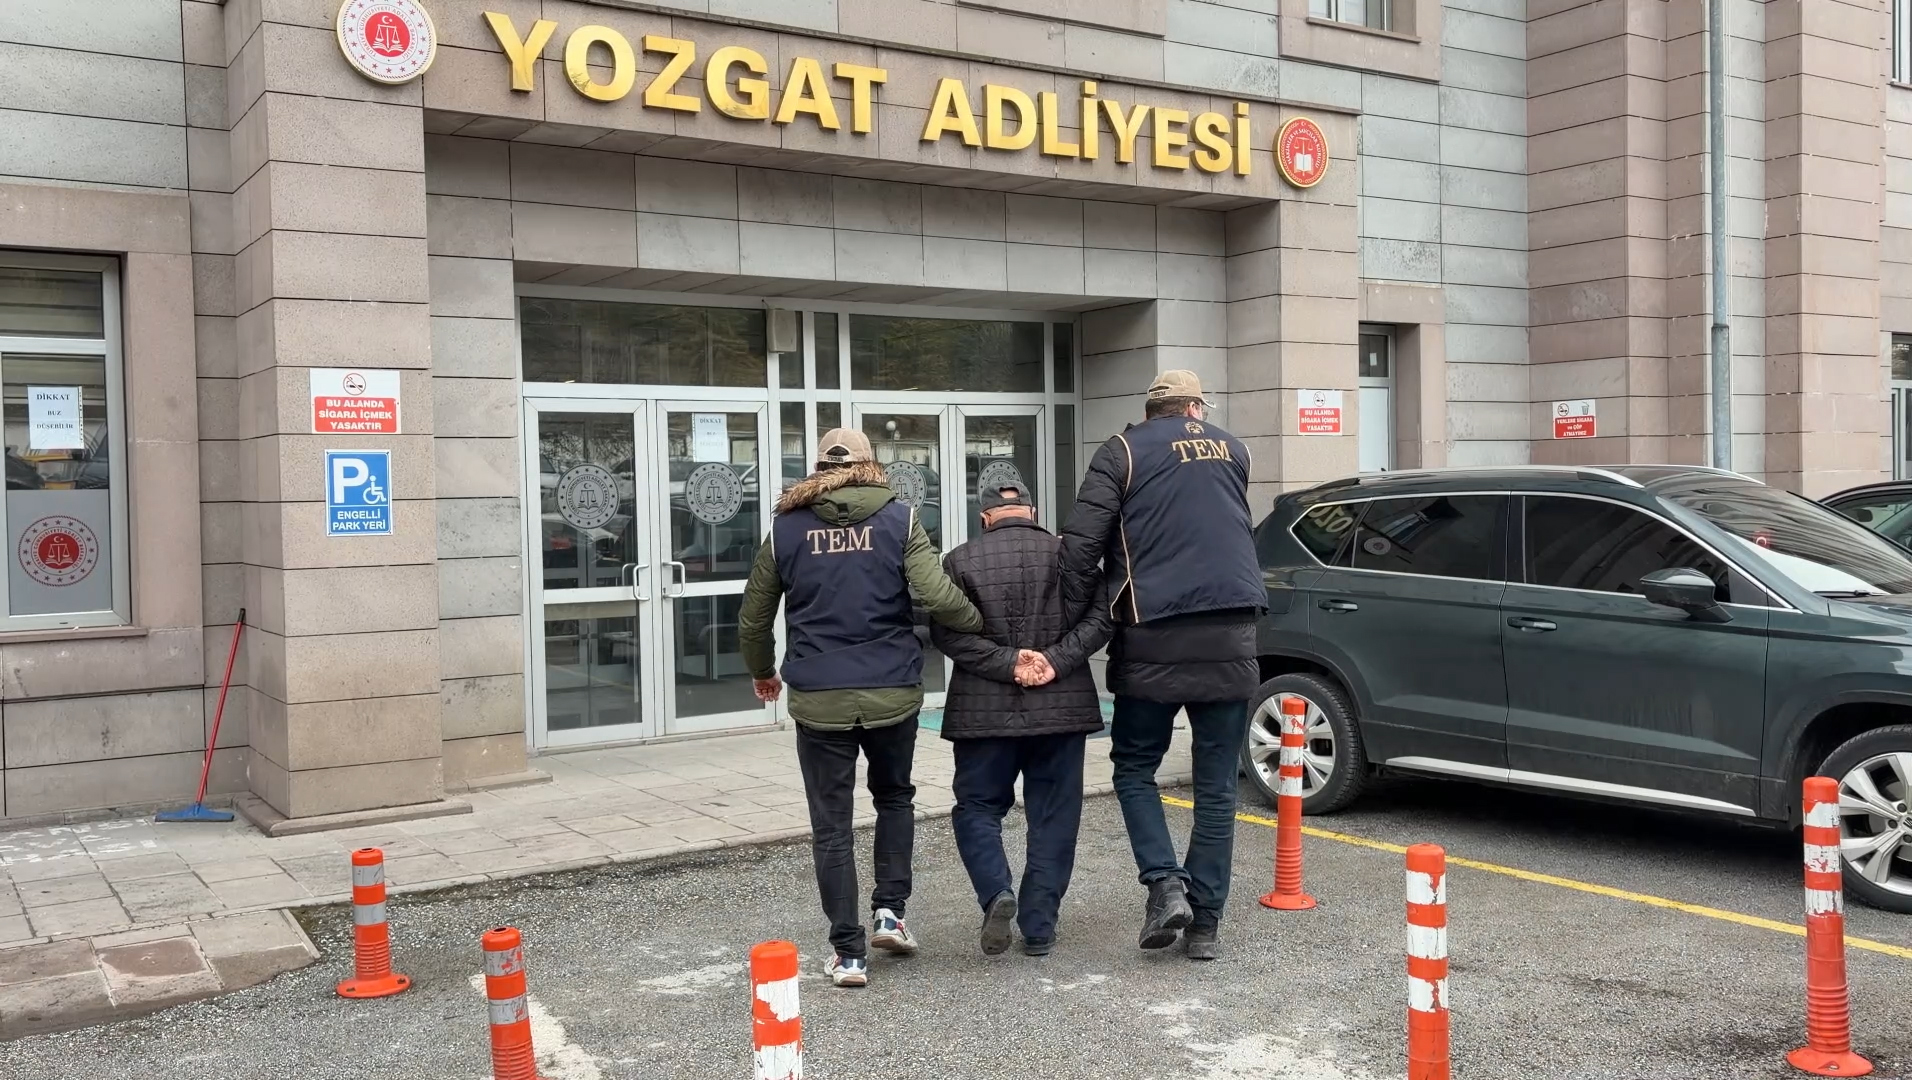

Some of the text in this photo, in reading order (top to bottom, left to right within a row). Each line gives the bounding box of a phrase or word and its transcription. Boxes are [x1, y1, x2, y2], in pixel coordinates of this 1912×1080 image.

[482, 11, 1252, 176] YOZGAT ADLİYESİ
[326, 399, 385, 408] BU ALANDA
[318, 409, 393, 421] SİGARA İÇMEK
[330, 421, 382, 431] YASAKTIR
[1171, 439, 1232, 463] TEM
[332, 458, 369, 504] P
[337, 508, 381, 520] ENGELLİ
[332, 519, 386, 531] PARK YERİ
[806, 525, 873, 555] TEM
